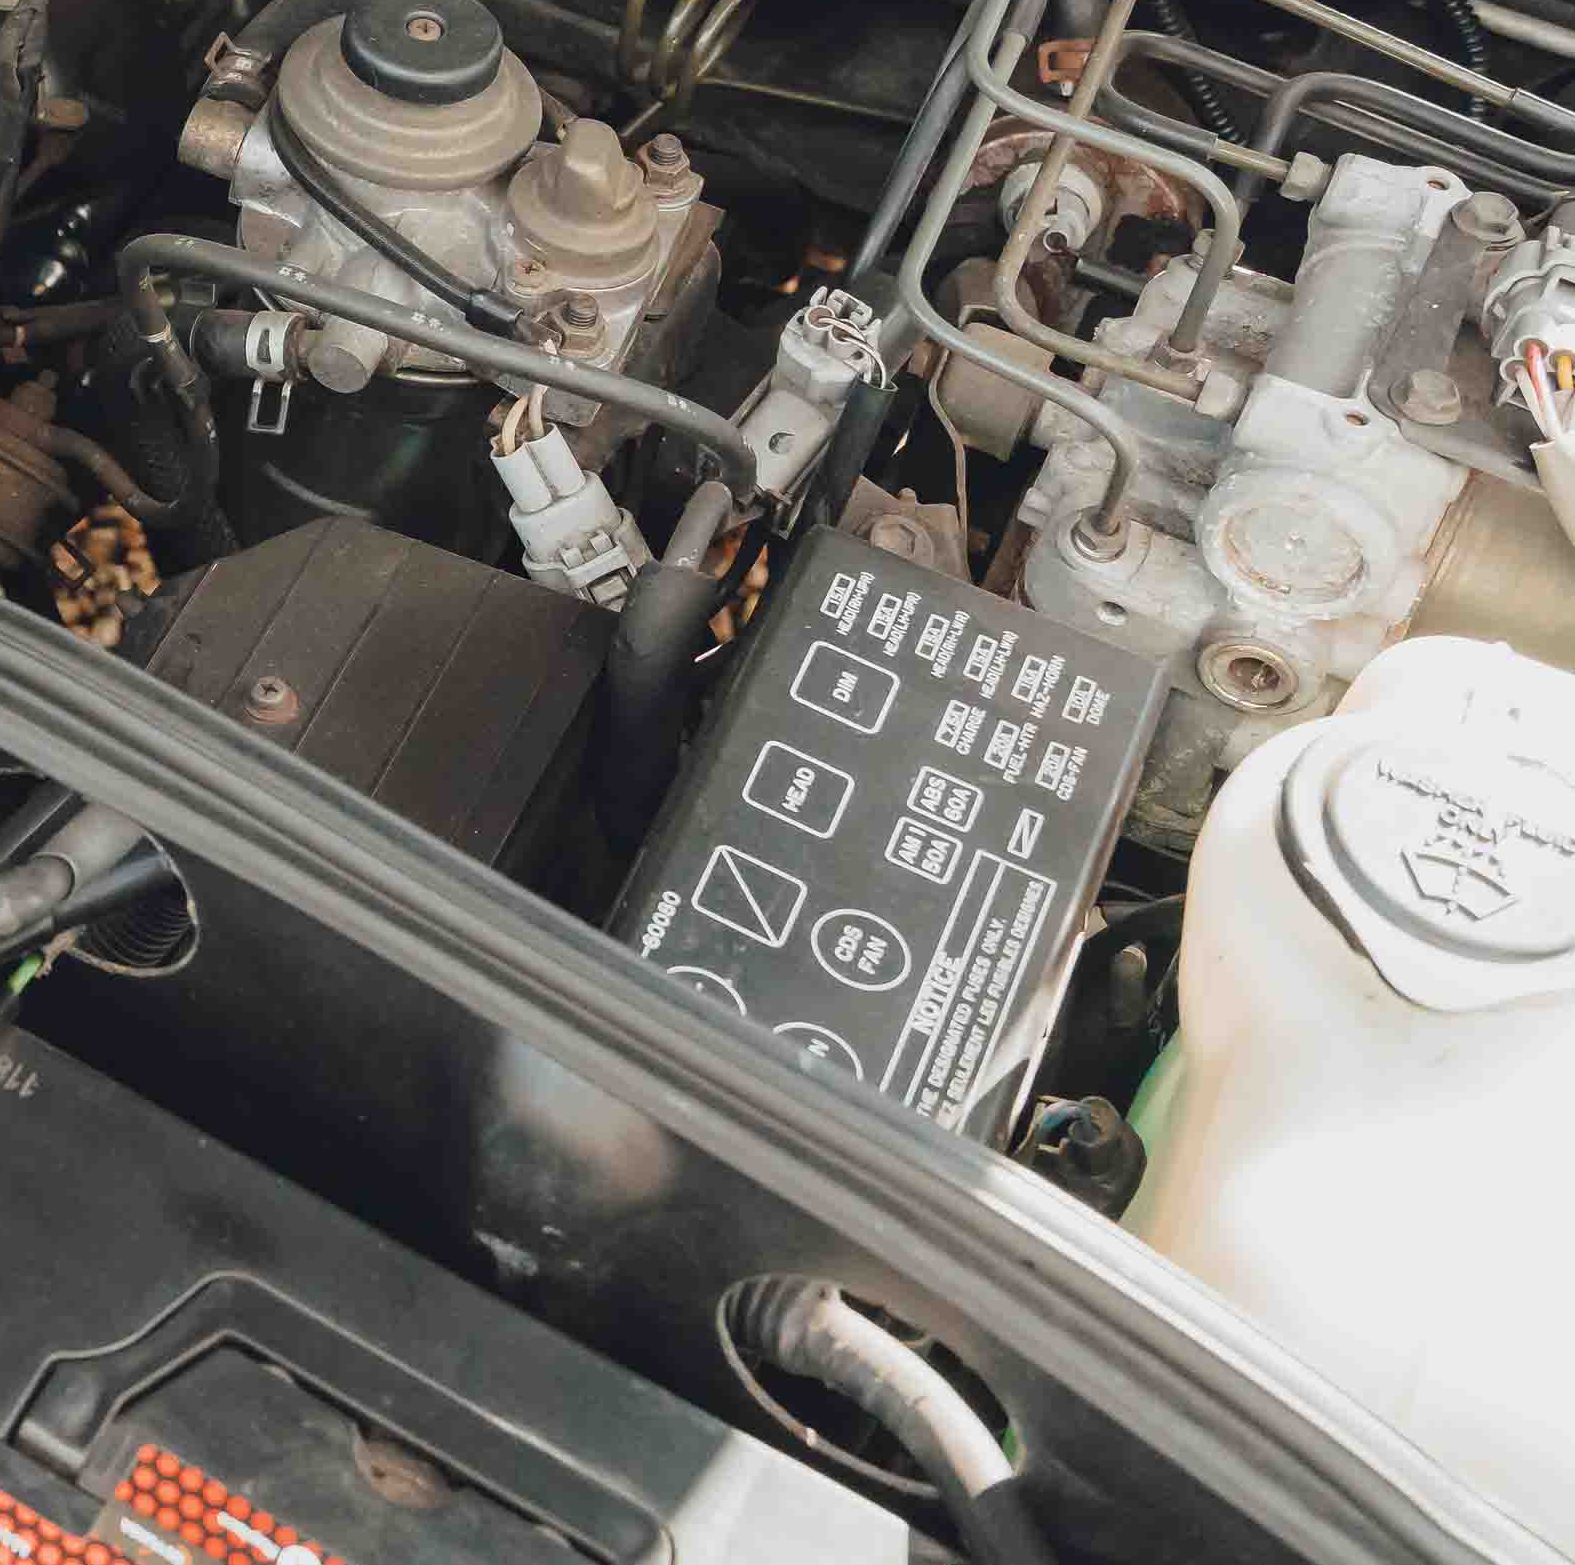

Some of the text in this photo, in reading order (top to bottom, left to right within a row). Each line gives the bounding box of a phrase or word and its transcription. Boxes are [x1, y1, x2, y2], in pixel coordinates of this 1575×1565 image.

[827, 580, 850, 607] 15A
[832, 569, 877, 636] HEAD(RH-UPR)
[874, 601, 896, 627] 15A
[877, 589, 925, 657] HEAD(LH-UPR)
[924, 608, 975, 680] HEAD(RH-LWR)
[831, 670, 862, 704] DIM
[972, 628, 1023, 699] HEAD(LH-LWR)
[1025, 653, 1070, 718] HAZ-HORN
[951, 704, 990, 757] CHARGE
[1083, 688, 1113, 726] DOME
[999, 720, 1043, 784] FUEL-HTR
[783, 766, 815, 814] HEAD
[917, 773, 949, 811] ABS
[830, 921, 865, 963] CDS
[853, 933, 890, 976] FAN
[908, 950, 963, 1035] NOTICE
[924, 1001, 977, 1089] DESIGNATED
[959, 954, 994, 1003] FUSES
